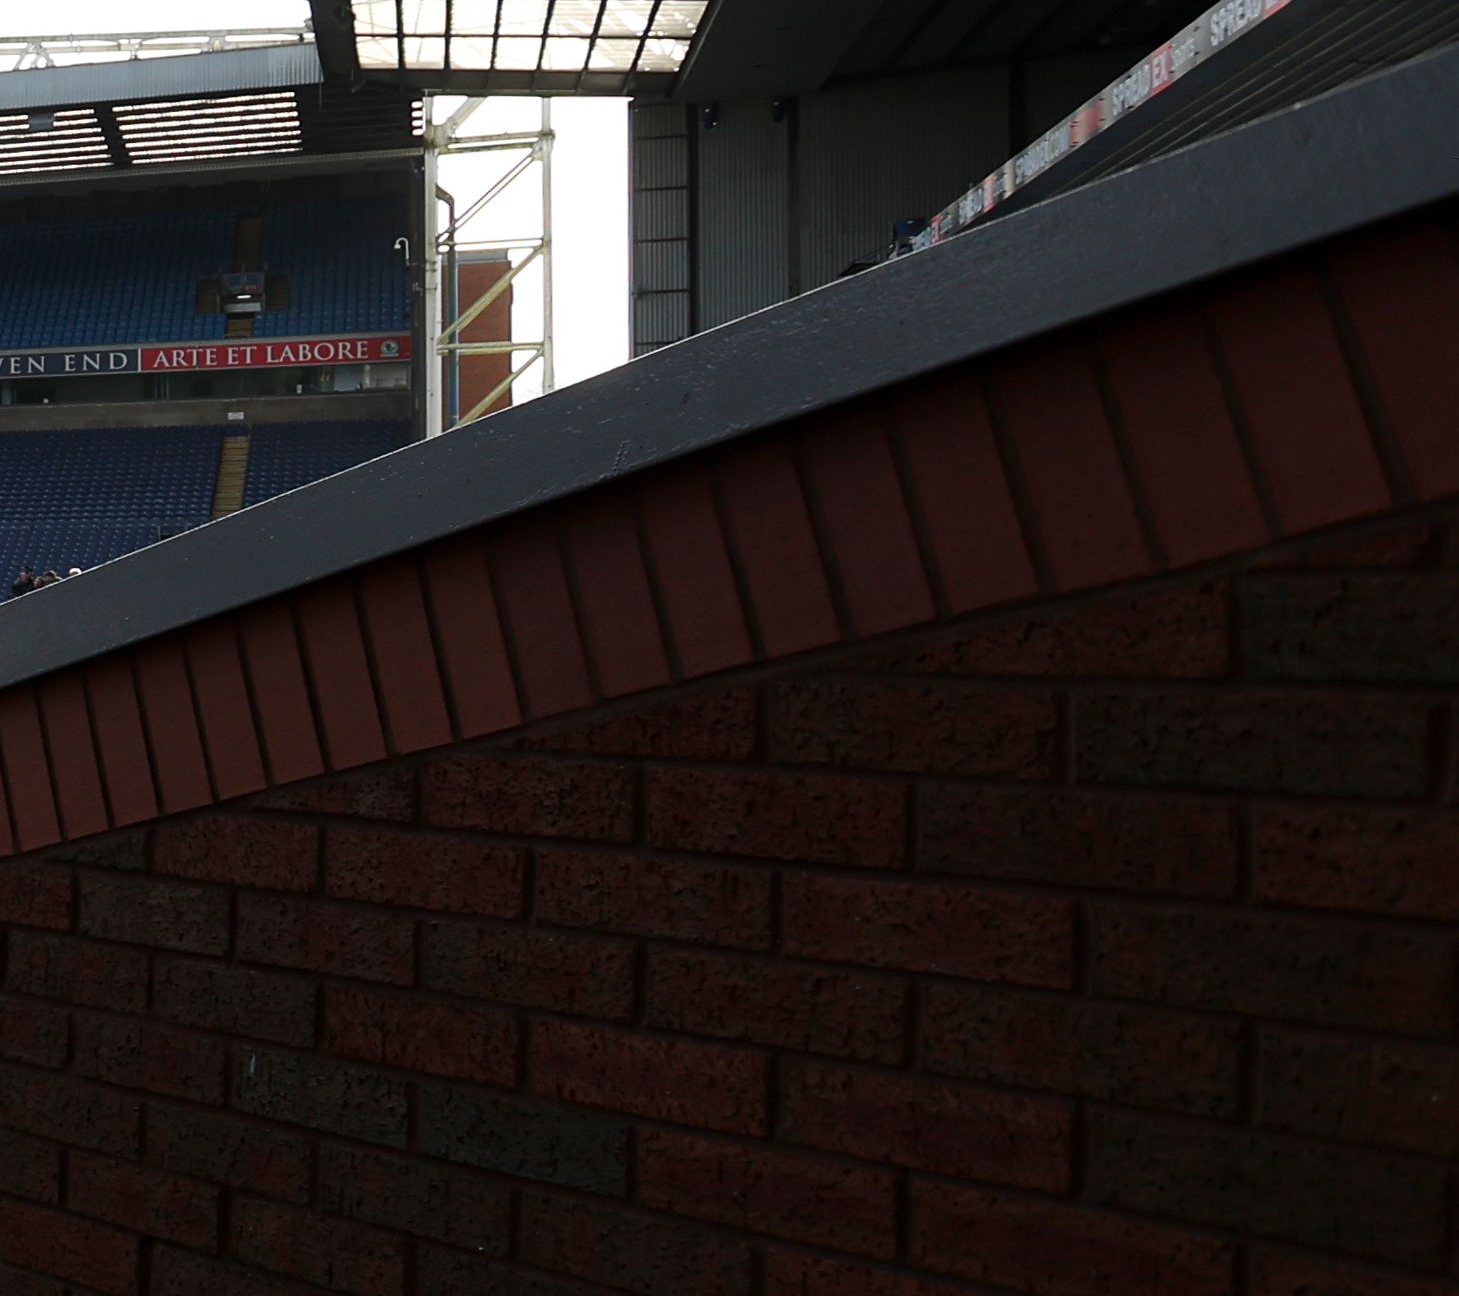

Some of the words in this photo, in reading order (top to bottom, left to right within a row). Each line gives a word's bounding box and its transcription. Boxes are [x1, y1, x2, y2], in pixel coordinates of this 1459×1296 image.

[64, 351, 128, 372] END
[152, 346, 217, 368] ARTE
[227, 345, 257, 365] ET
[266, 340, 369, 364] LABORE
